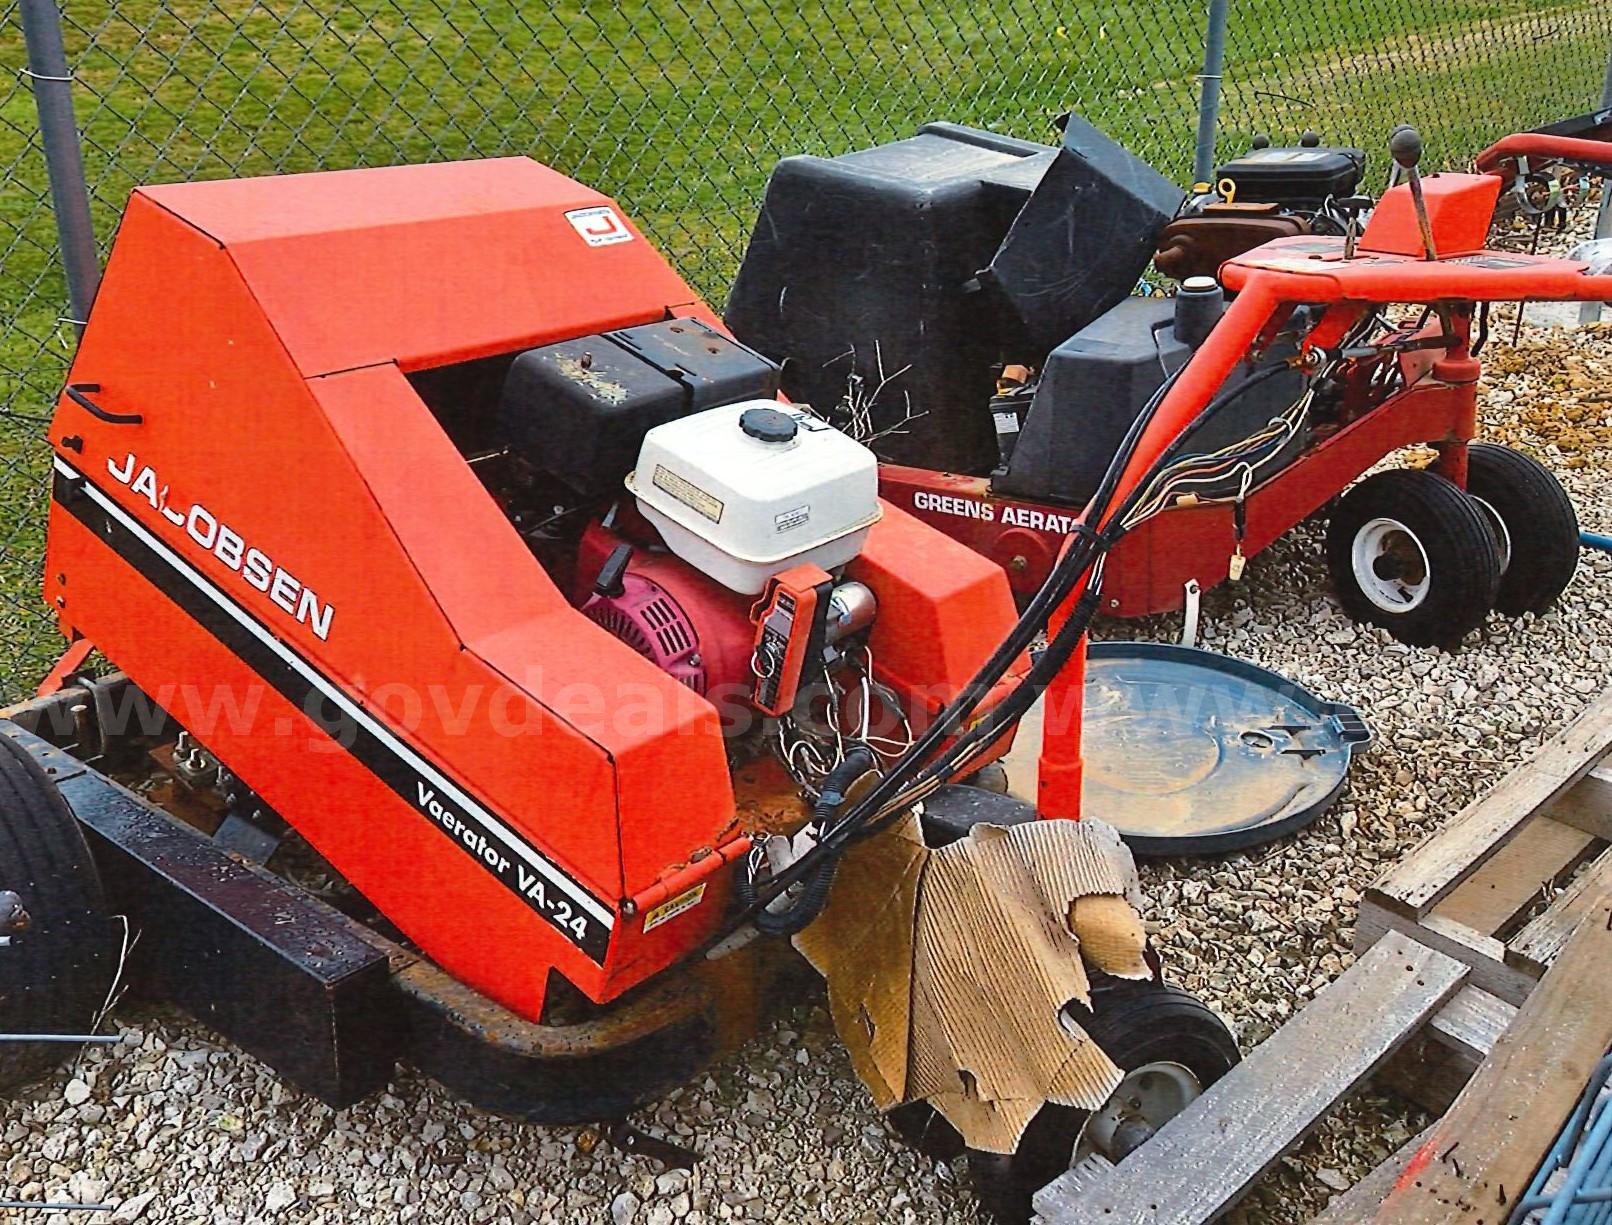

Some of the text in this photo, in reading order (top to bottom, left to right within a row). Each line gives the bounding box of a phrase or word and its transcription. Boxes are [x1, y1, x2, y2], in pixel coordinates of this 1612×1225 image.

[914, 491, 1079, 535] GREENS AERAT
[416, 781, 511, 874] Vaerator
[516, 864, 589, 941] VA-24
